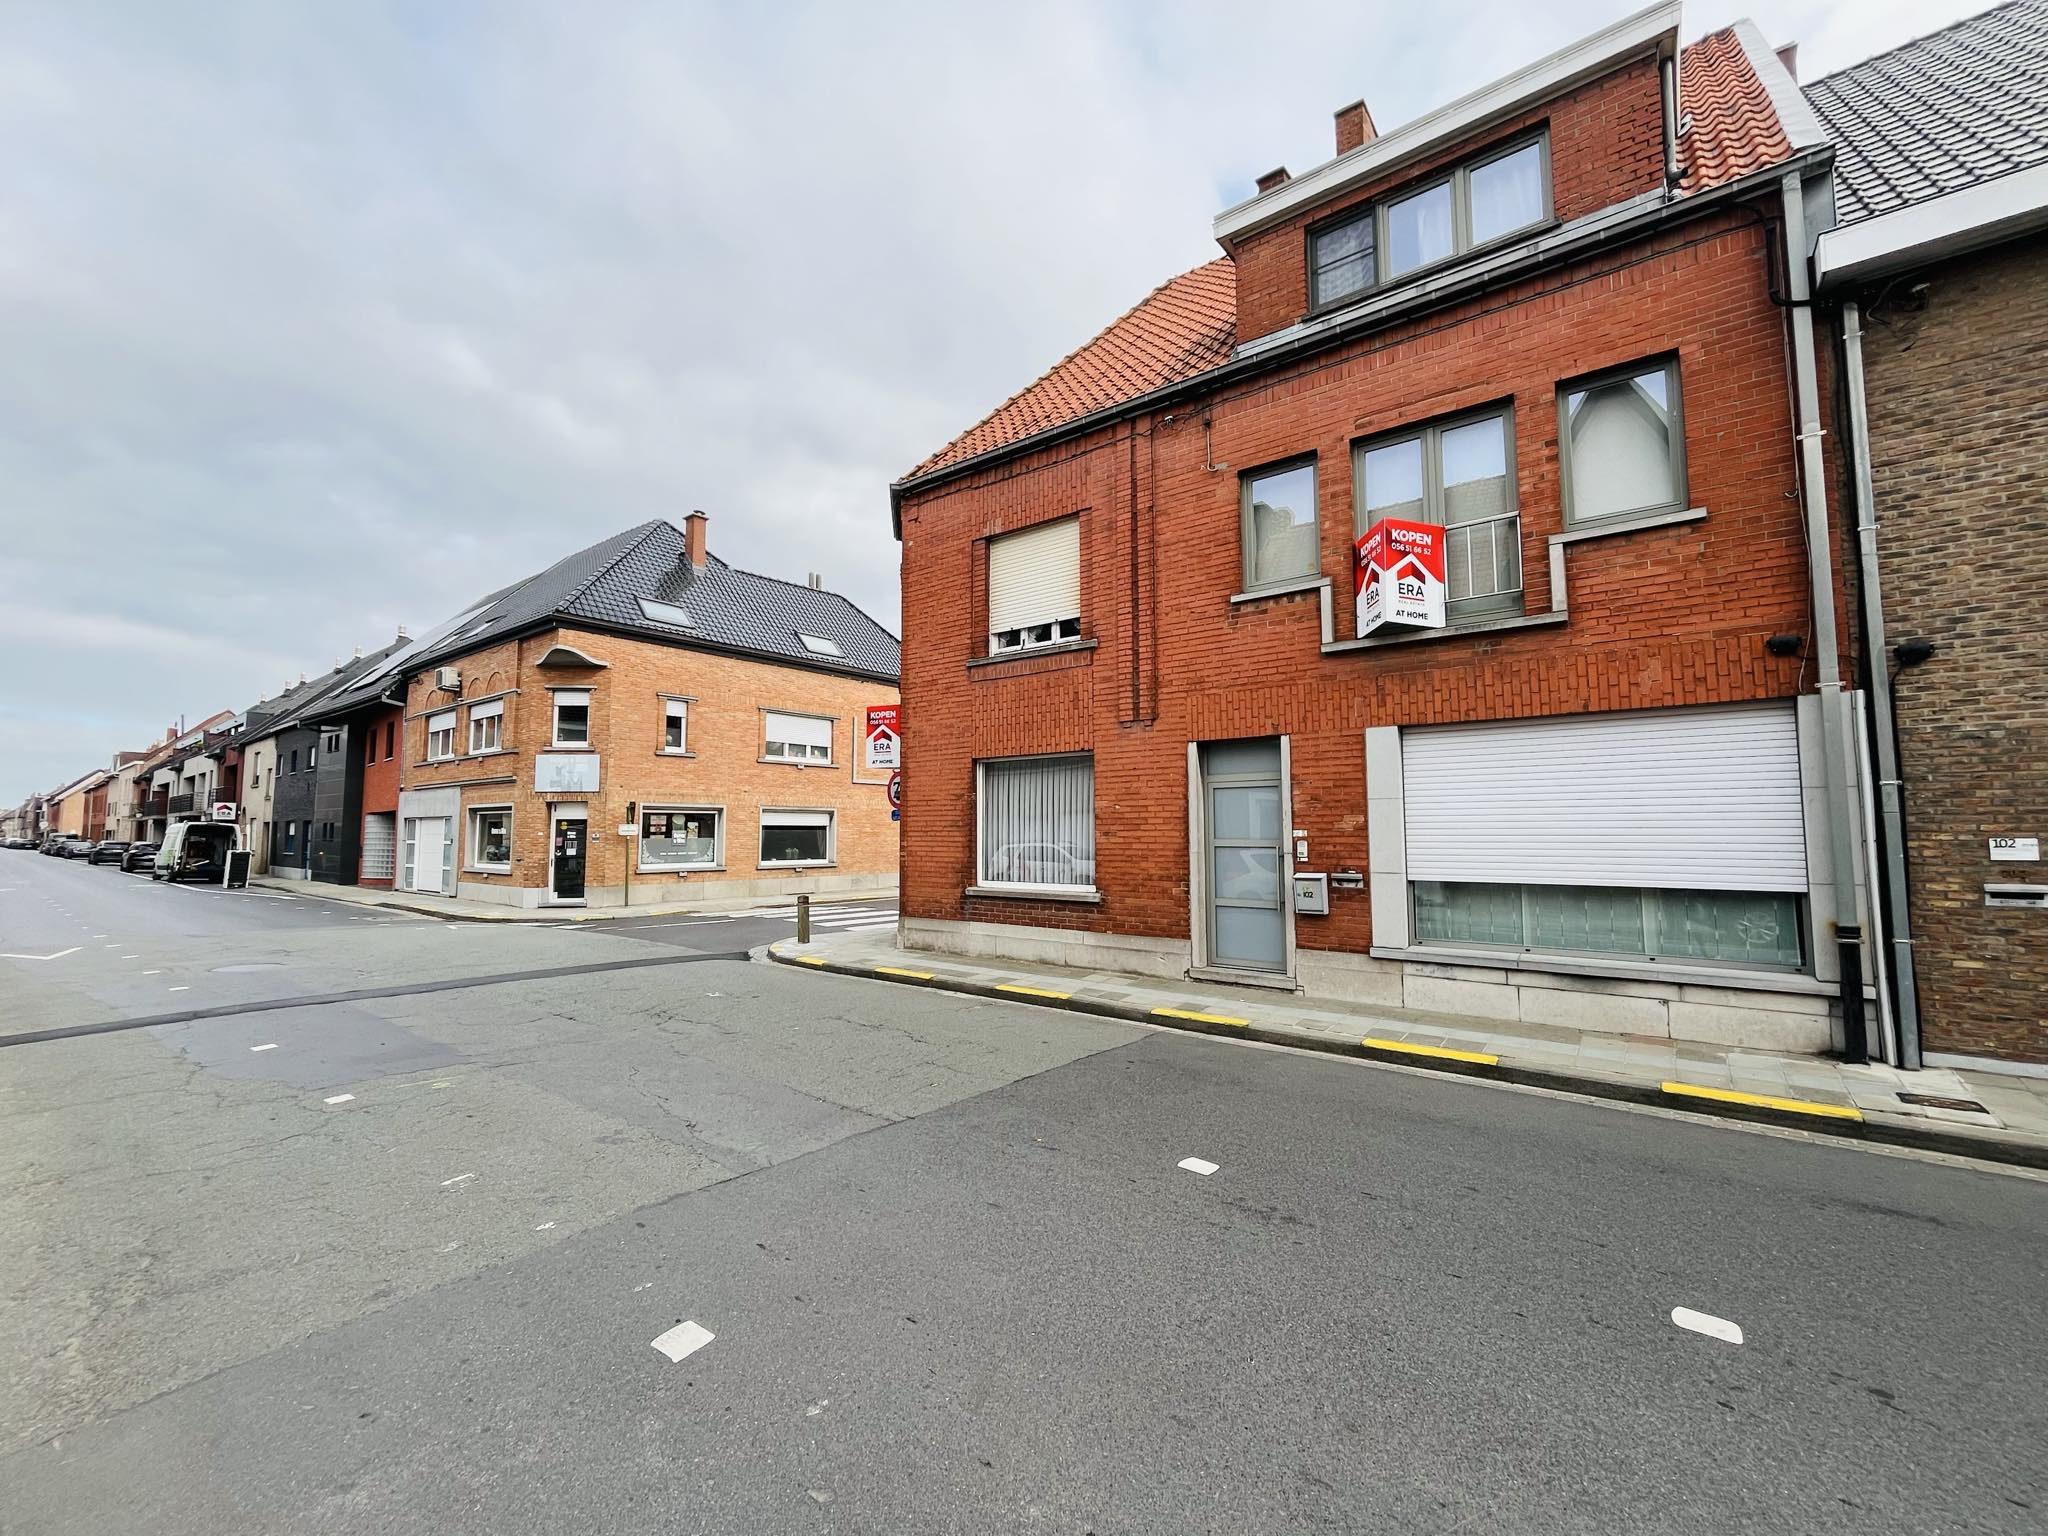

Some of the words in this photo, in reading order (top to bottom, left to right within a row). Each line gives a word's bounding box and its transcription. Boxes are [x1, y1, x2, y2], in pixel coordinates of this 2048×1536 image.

[1391, 529, 1432, 545] KOPEN
[1361, 532, 1381, 558] KOPEN
[1391, 542, 1405, 551] 056
[1405, 544, 1412, 552] 51
[1366, 587, 1380, 605] ERA
[1398, 583, 1425, 597] ERA
[1406, 611, 1428, 620] HOME
[870, 711, 896, 719] KOPEN
[1992, 838, 2016, 848] 102
